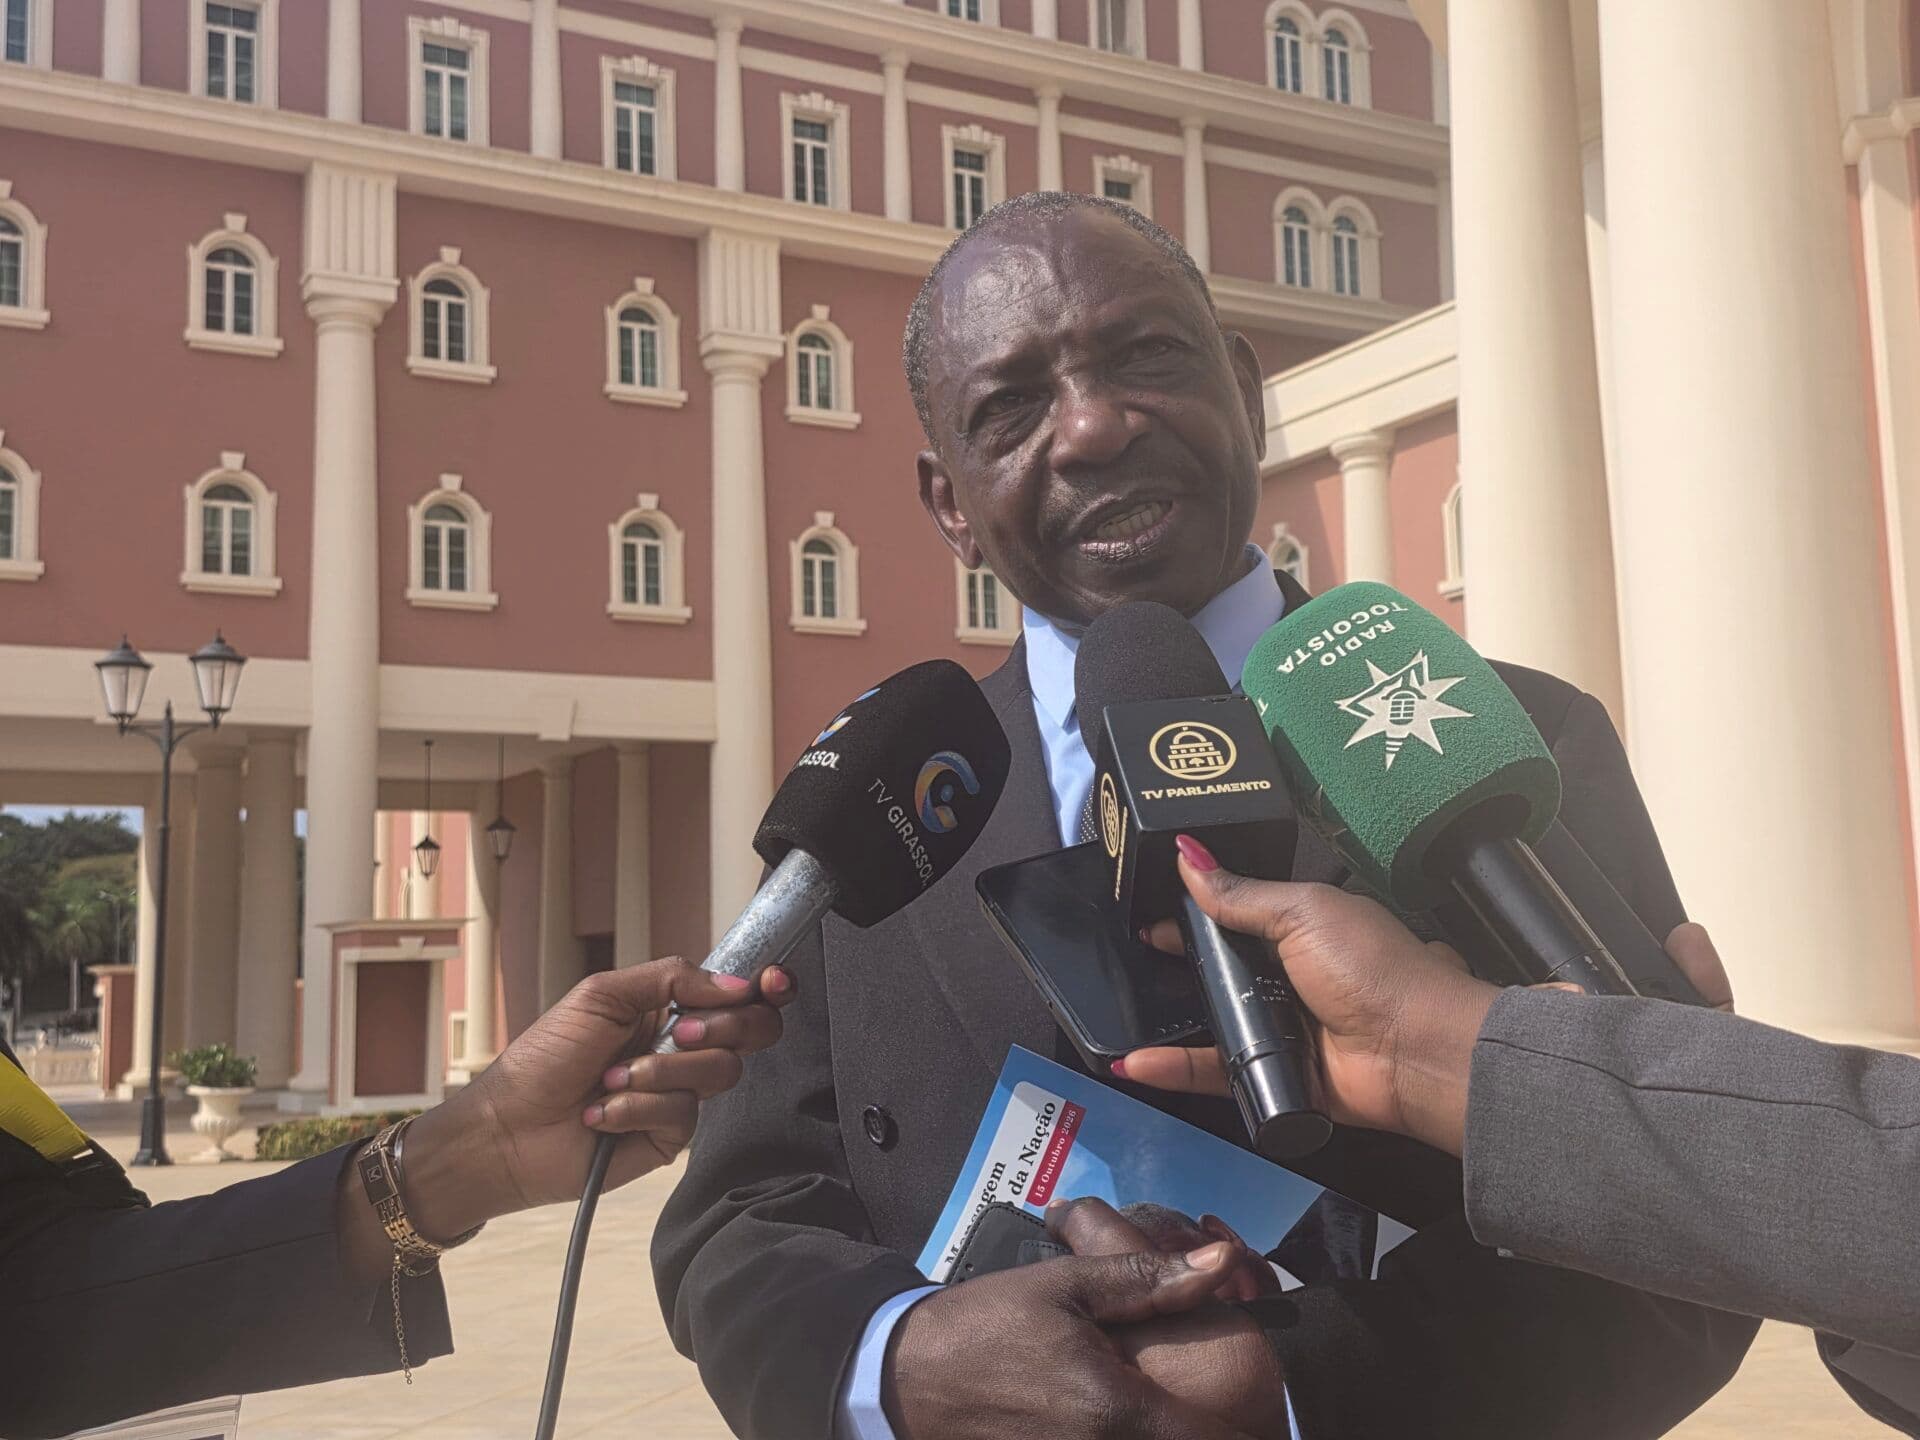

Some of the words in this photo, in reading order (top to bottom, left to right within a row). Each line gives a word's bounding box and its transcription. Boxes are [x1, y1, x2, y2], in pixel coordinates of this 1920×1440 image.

[1277, 602, 1408, 673] TOCOISTA
[1320, 620, 1396, 666] RADIO
[1142, 789, 1163, 800] TV
[1167, 780, 1271, 799] PARLAMENTO
[868, 778, 893, 804] TV
[888, 806, 935, 887] GIRASSOL
[1018, 1102, 1056, 1167] Nação
[1008, 1169, 1029, 1195] da
[1034, 1186, 1045, 1198] 15
[1042, 1137, 1065, 1183] Outubro
